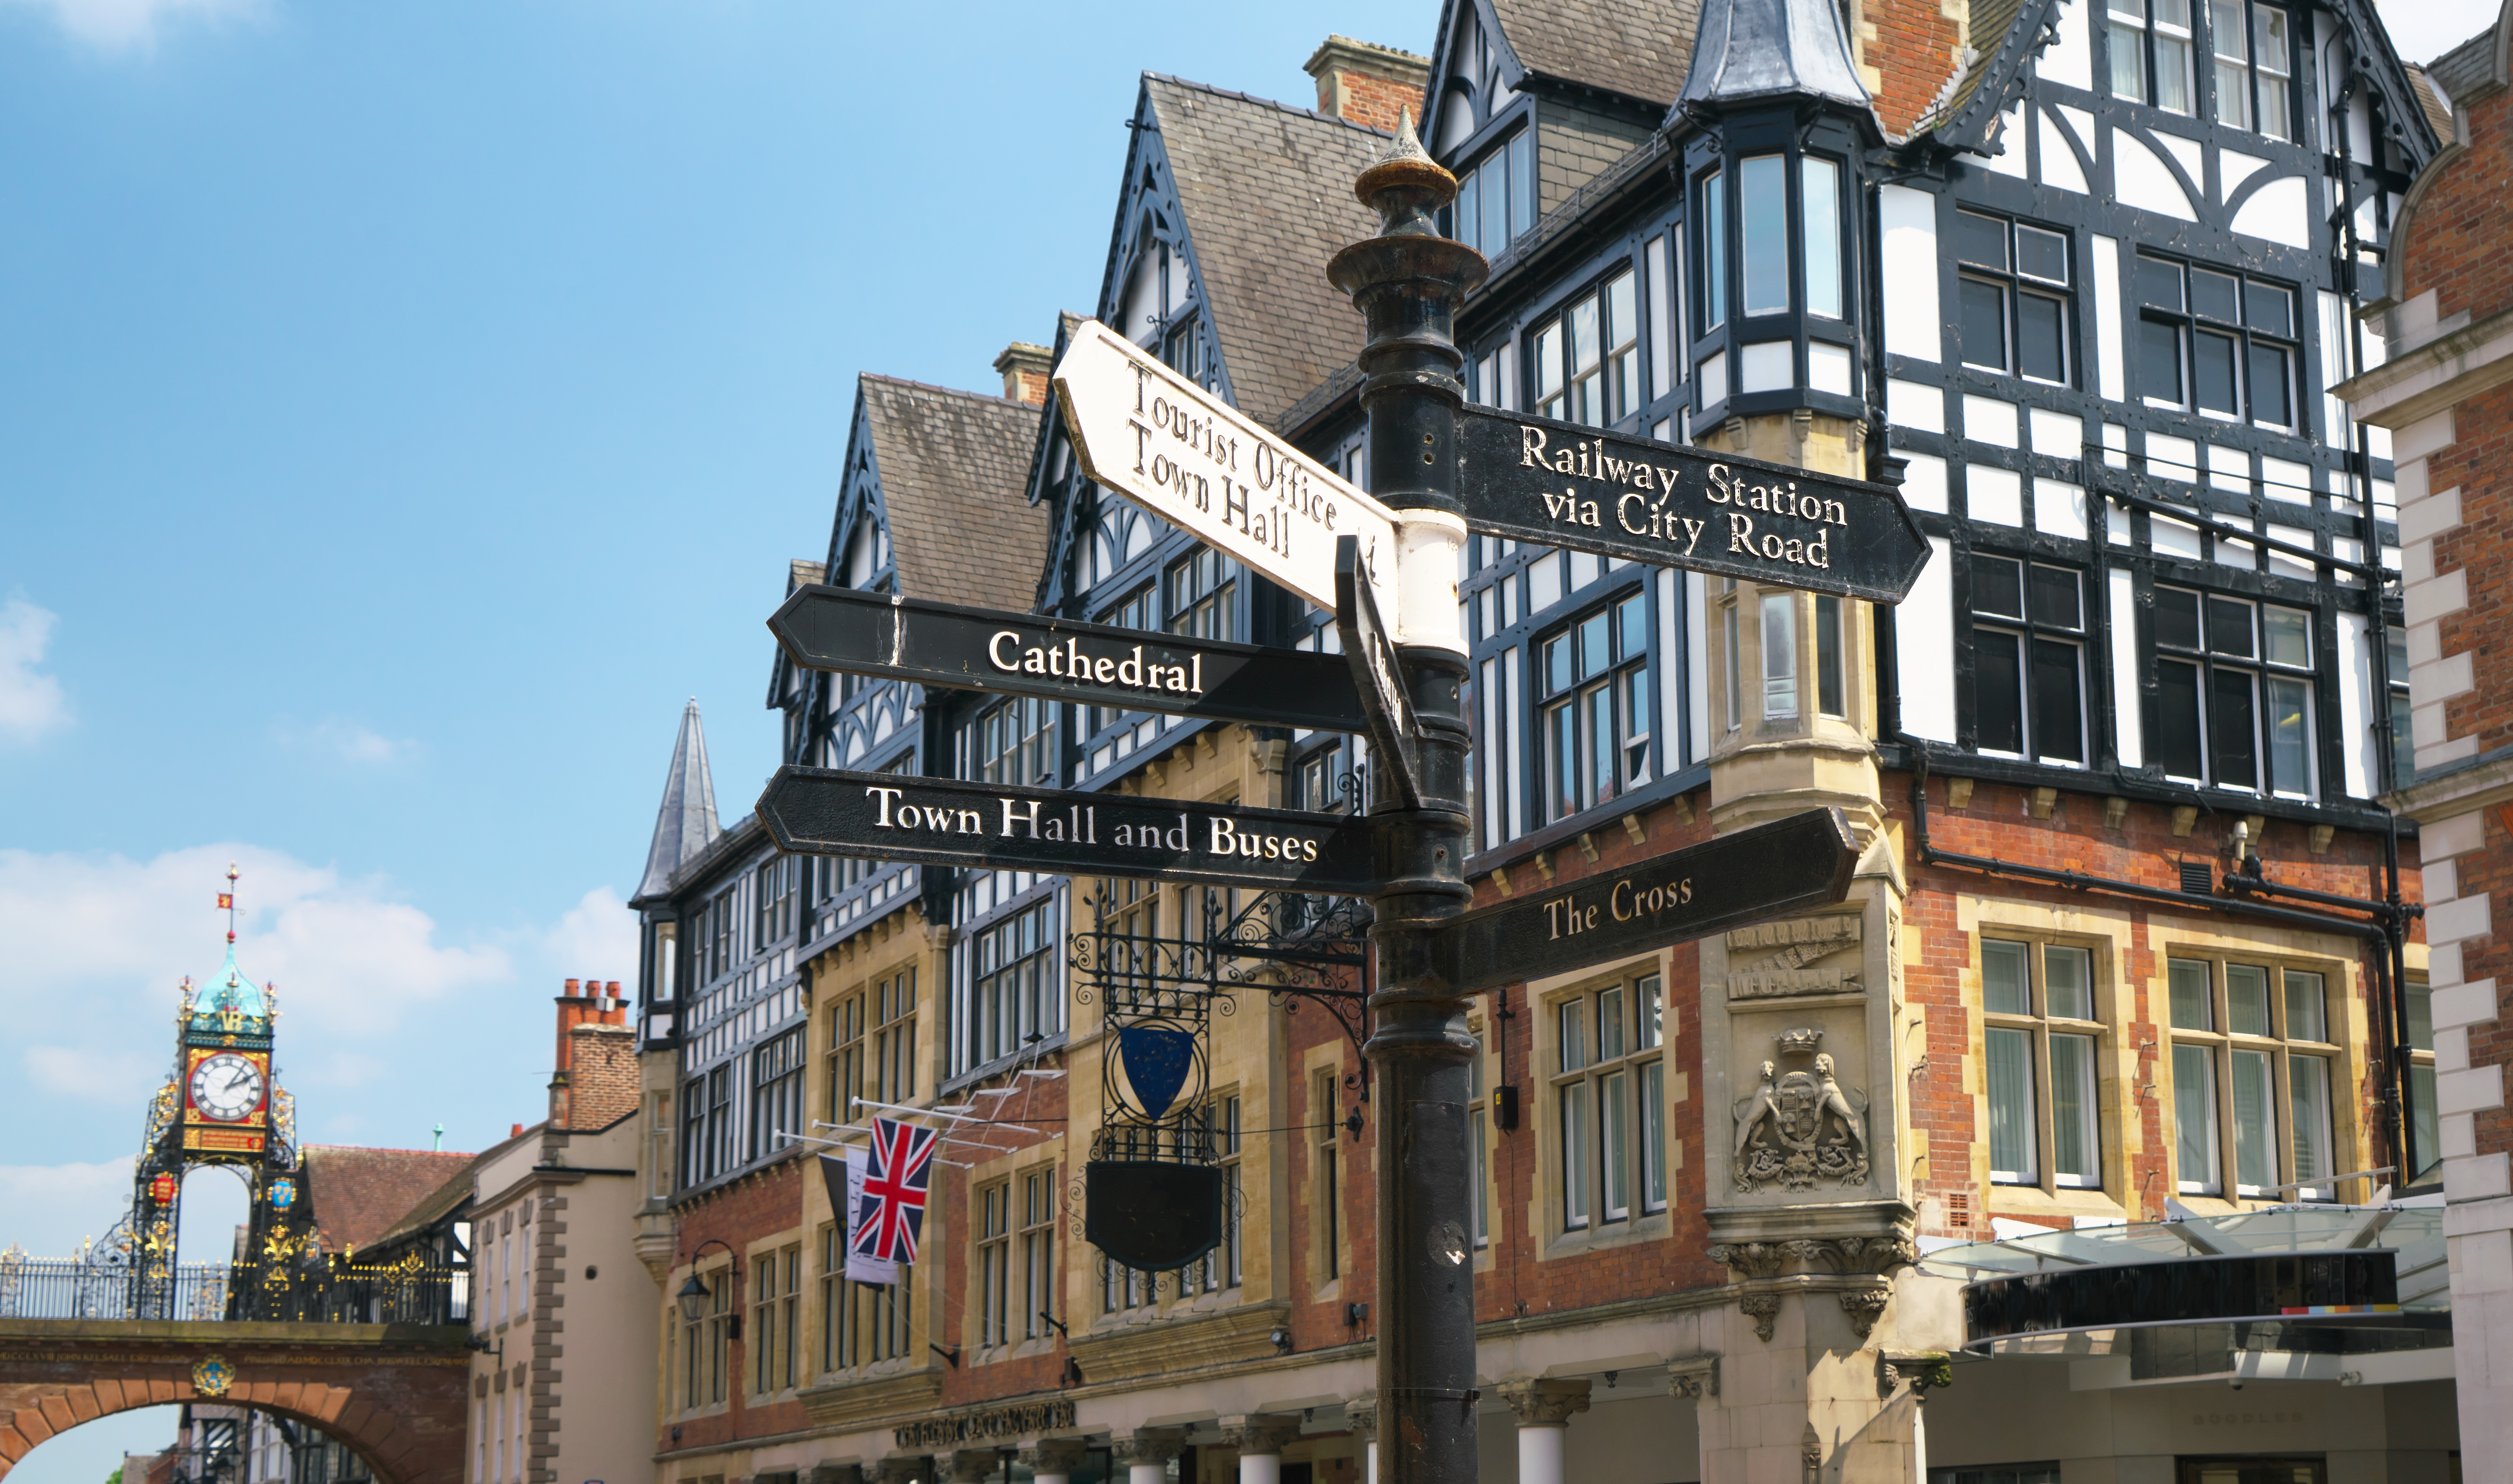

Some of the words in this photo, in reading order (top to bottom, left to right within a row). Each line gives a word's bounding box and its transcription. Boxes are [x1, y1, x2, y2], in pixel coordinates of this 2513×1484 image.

[1127, 359, 1238, 472] Tourist
[1253, 440, 1338, 531] Office
[1519, 425, 1679, 507] Railway
[1705, 463, 1848, 527] Station
[1126, 417, 1210, 513] Town
[1221, 474, 1289, 558] Hall
[1541, 488, 1601, 527] via
[1617, 494, 1705, 556] City
[1726, 513, 1829, 569] Road
[988, 631, 1203, 695] Cathedral
[865, 787, 981, 835] Town
[999, 798, 1096, 846] Hall
[1114, 813, 1189, 853] and
[1209, 816, 1318, 863] Buses
[1543, 897, 1598, 941] The
[1610, 879, 1693, 922] Cross
[221, 1010, 242, 1031] VR
[186, 1108, 201, 1122] 18
[249, 1111, 267, 1124] 97
